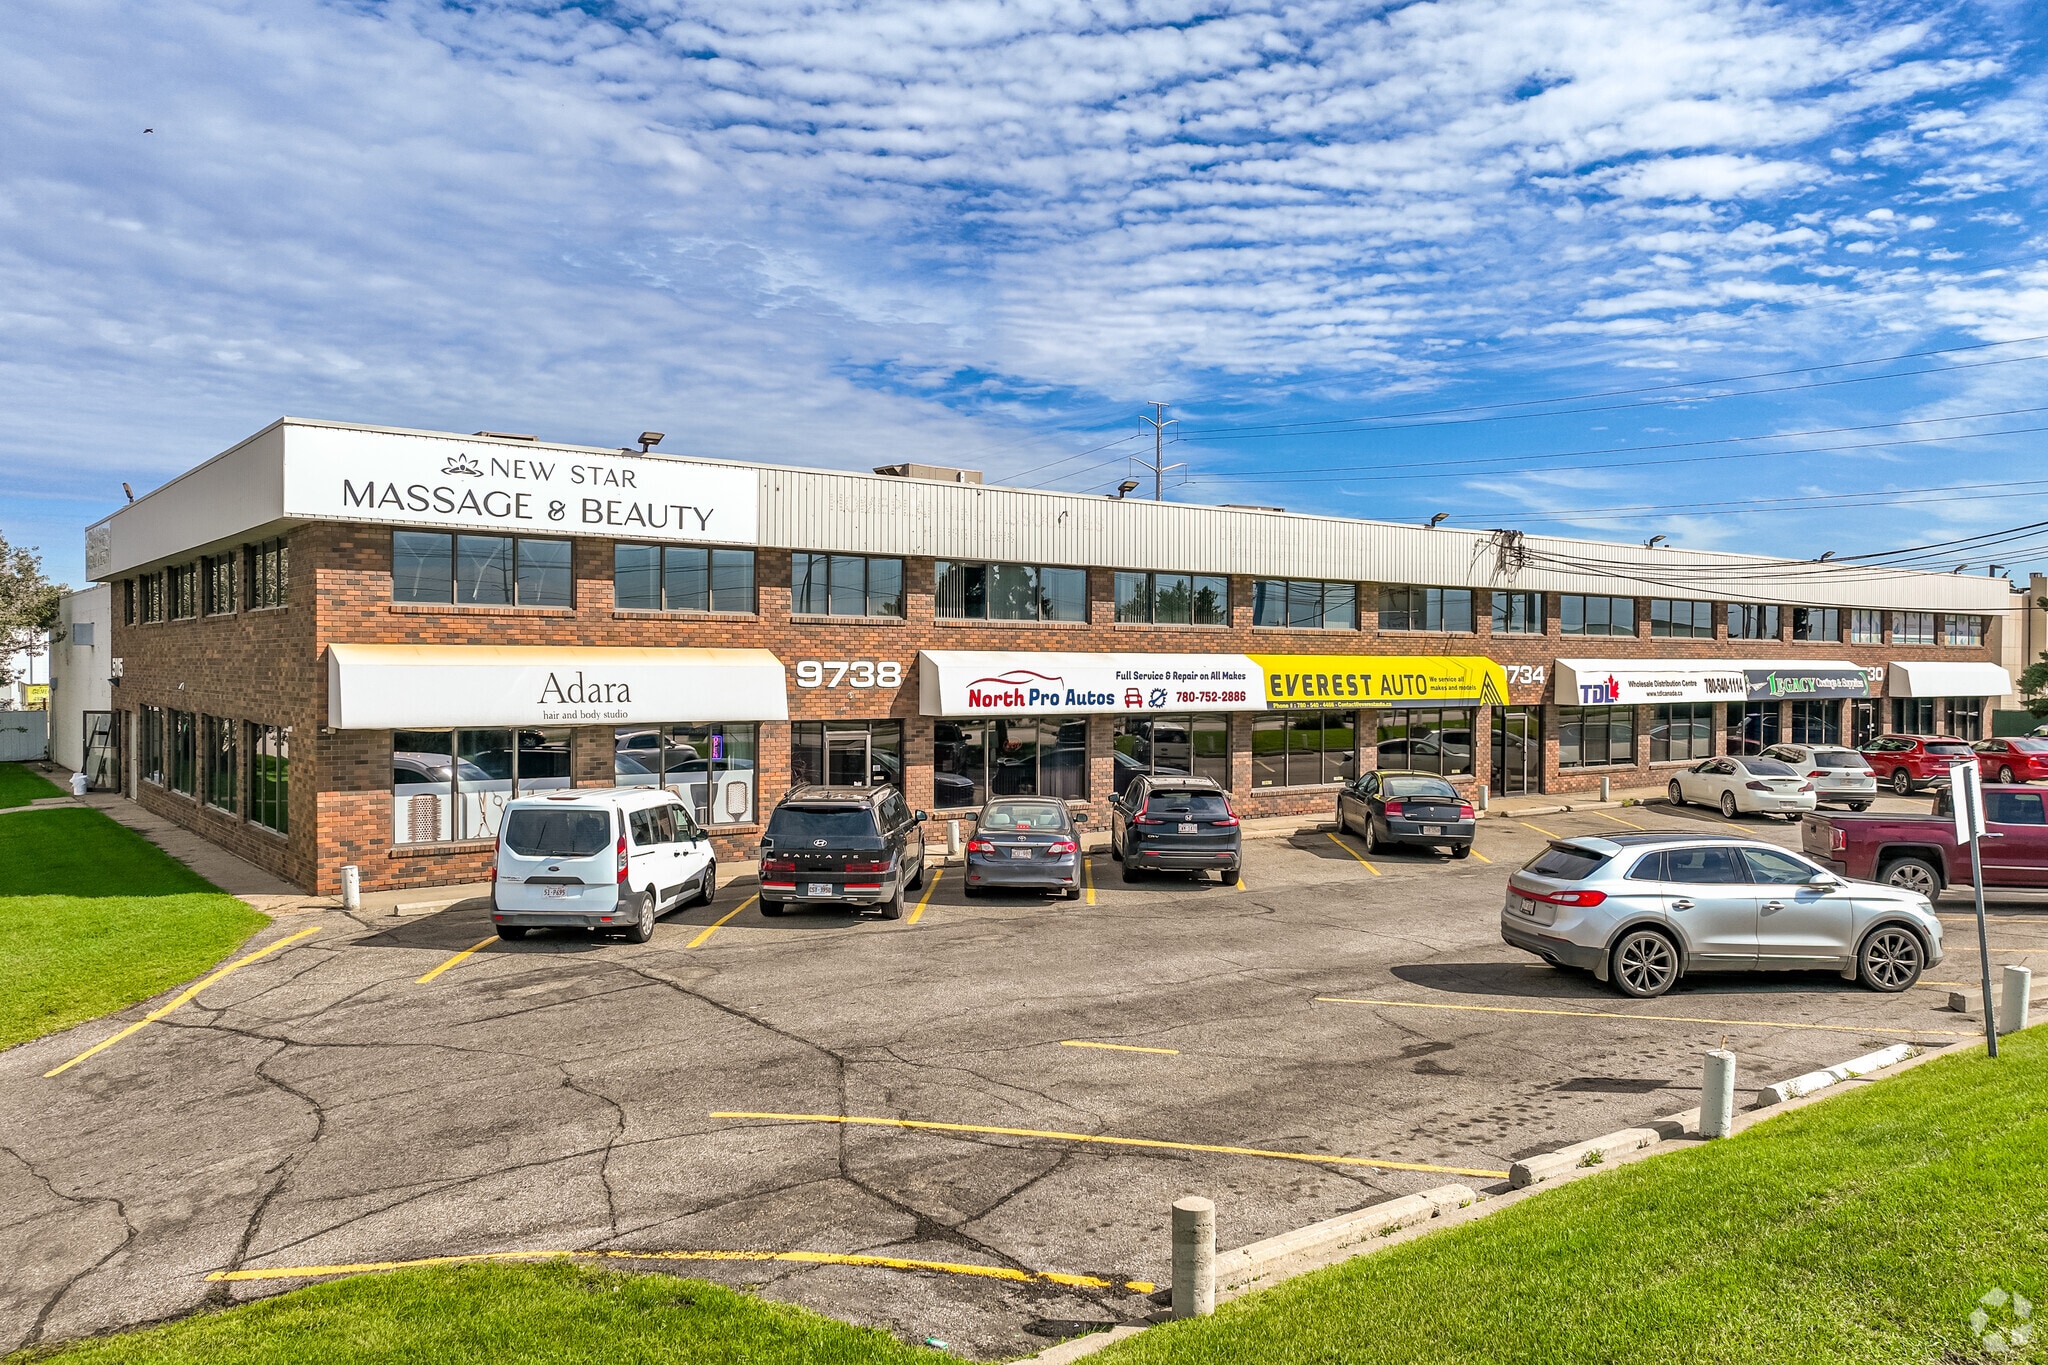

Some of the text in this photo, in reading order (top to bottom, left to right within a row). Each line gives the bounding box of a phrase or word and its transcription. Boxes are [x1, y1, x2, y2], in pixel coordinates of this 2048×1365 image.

[491, 457, 637, 488] NEW STAR
[343, 479, 714, 531] MASSAGE & BEAUTY
[796, 660, 902, 688] 9738
[1116, 671, 1131, 681] Full
[1133, 671, 1164, 681] Service
[1165, 671, 1171, 680] &
[1172, 671, 1198, 682] Repair
[1210, 671, 1221, 680] All
[1222, 671, 1246, 680] Makes
[1500, 665, 1545, 684] 734
[1767, 671, 1816, 697] LEGACY
[1866, 666, 1884, 682] 30
[536, 671, 632, 704] Adara
[1270, 674, 1428, 696] EVEREST AUTO
[1580, 682, 1614, 703] TDL
[1704, 678, 1744, 693] 780-540-1114
[968, 688, 1115, 708] North Pro Autos
[1176, 691, 1246, 703] 780-752-2886
[543, 709, 628, 721] hair and body studio
